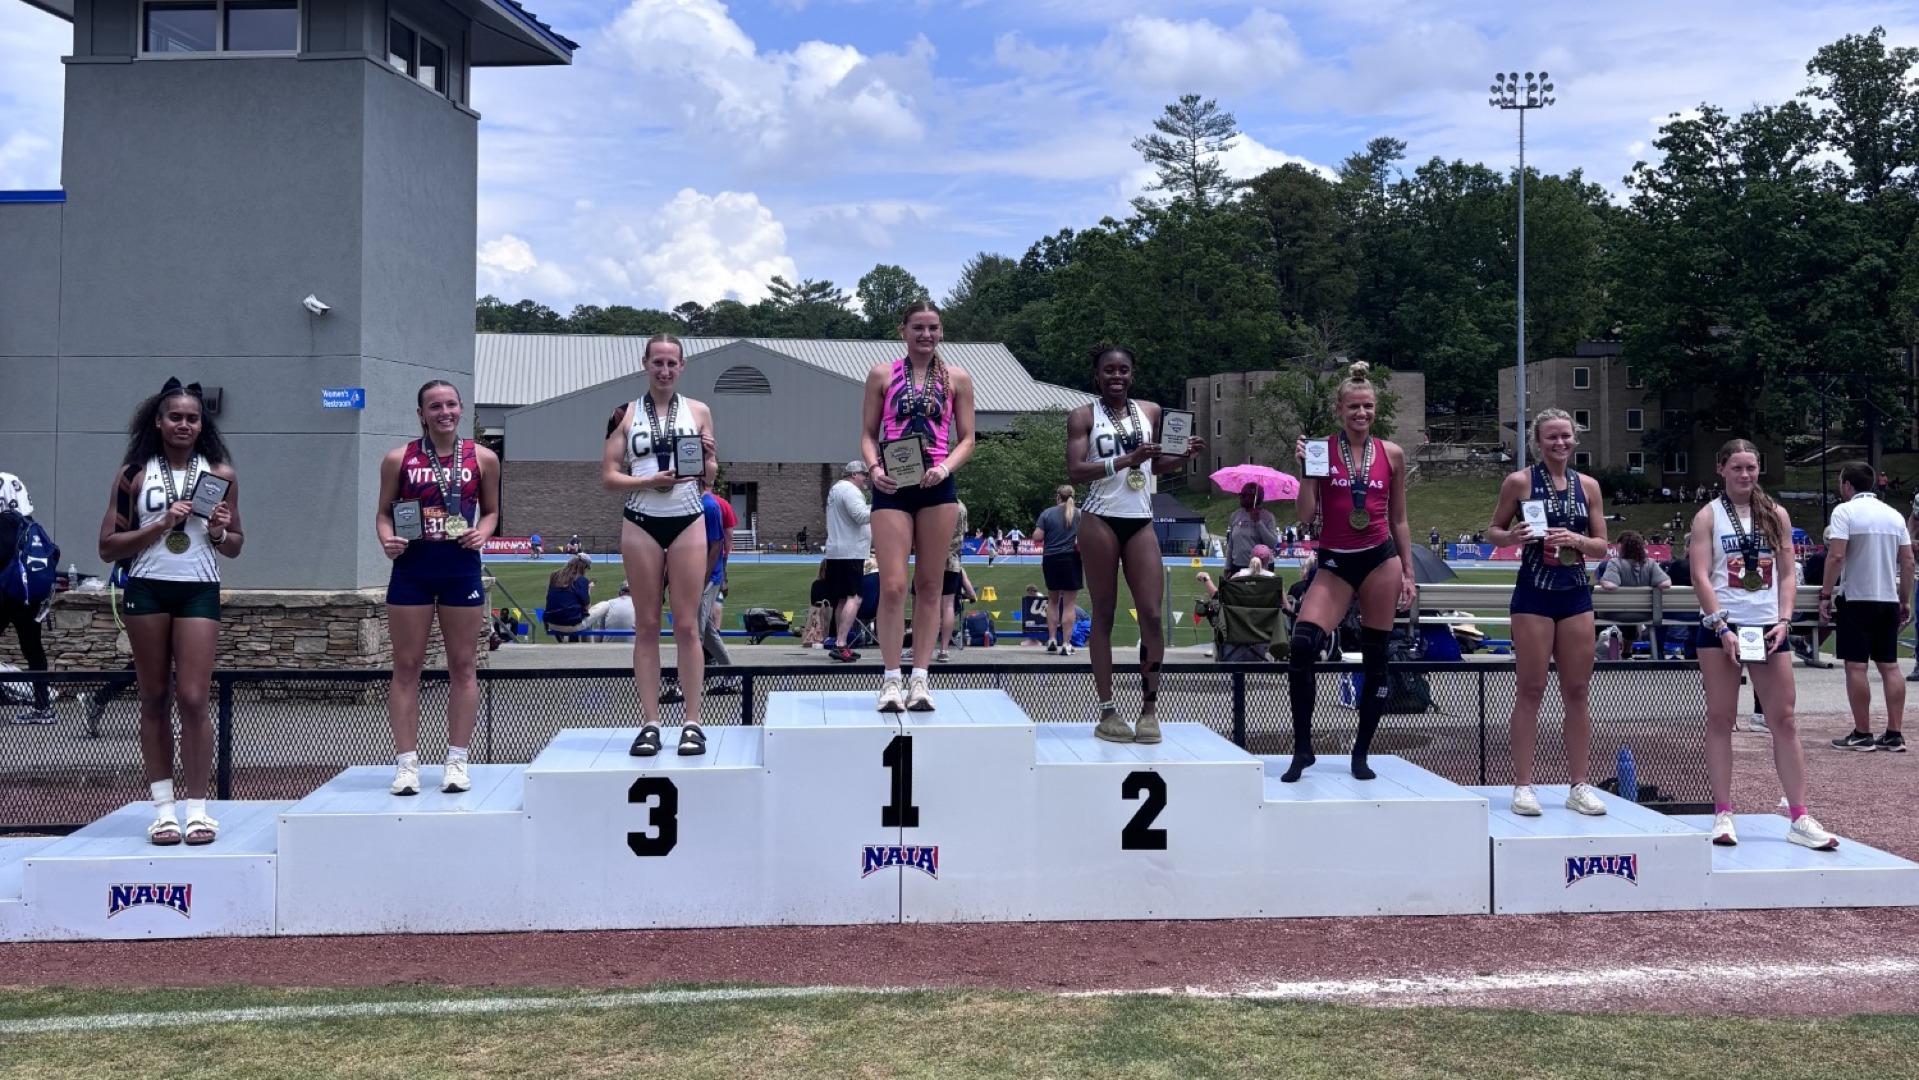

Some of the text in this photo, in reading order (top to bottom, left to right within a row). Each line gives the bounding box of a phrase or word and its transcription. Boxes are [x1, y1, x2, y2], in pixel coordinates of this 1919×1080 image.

[322, 389, 349, 398] Women's
[323, 399, 352, 408] Restroom
[408, 467, 472, 484] VITERO
[883, 734, 919, 835] 1
[628, 777, 678, 856] 3
[1122, 772, 1167, 850] 2
[862, 846, 938, 877] NAIA
[1566, 854, 1637, 886] NAIA
[108, 884, 191, 917] NAIA
